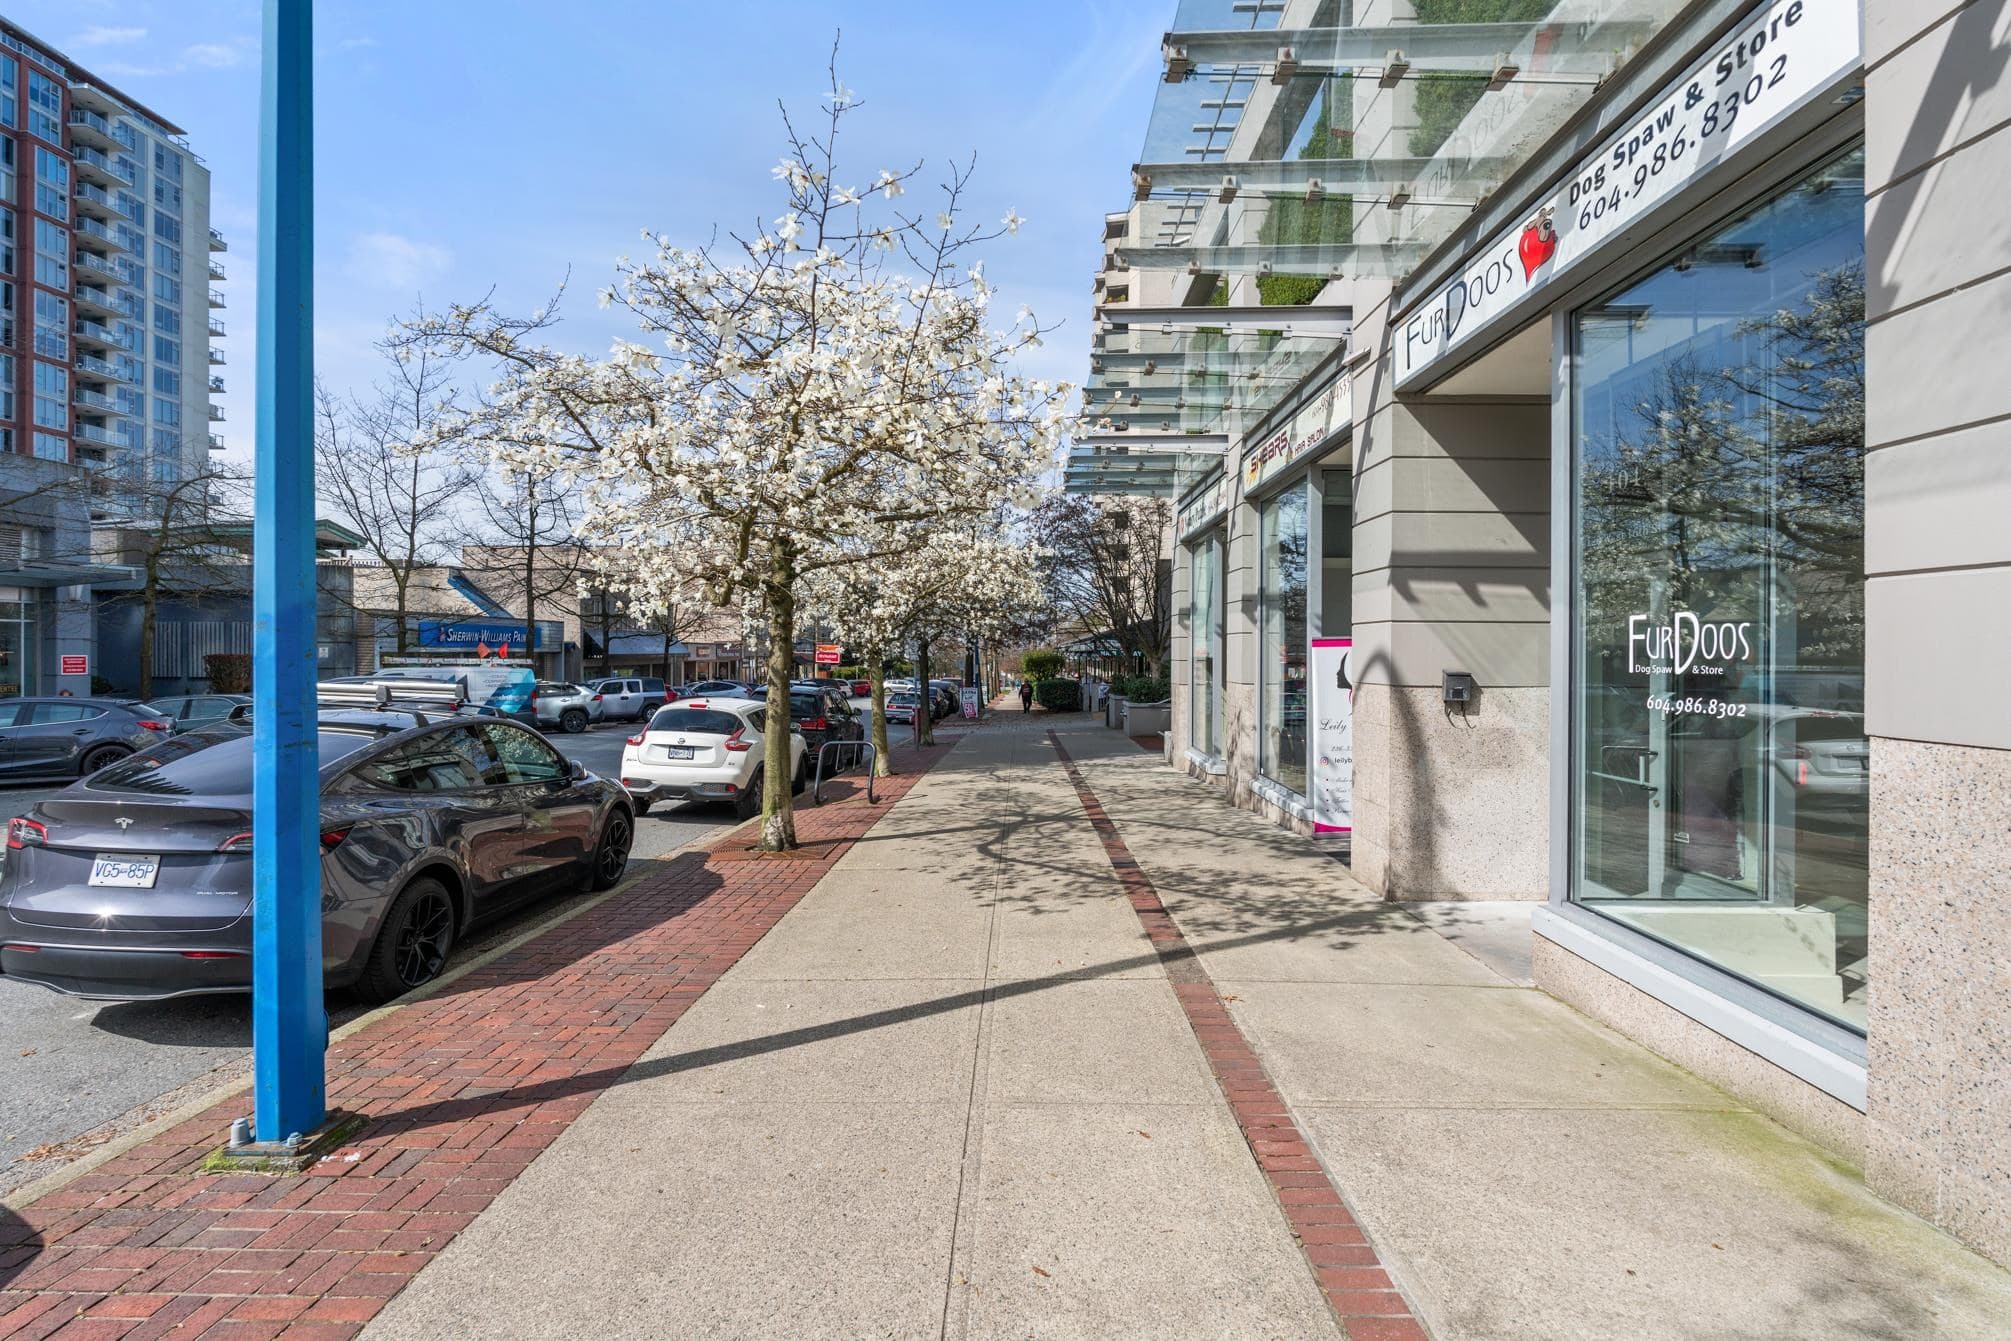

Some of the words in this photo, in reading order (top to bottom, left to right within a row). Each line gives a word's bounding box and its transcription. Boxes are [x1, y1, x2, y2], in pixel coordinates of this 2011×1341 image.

[1569, 163, 1606, 207] Dog
[1612, 103, 1676, 172] Spaw
[1684, 81, 1705, 111] &
[1715, 0, 1804, 87] Store
[1579, 53, 1788, 231] 604.986.8302
[1635, 664, 1651, 675] Dog
[1651, 664, 1673, 675] Spaw
[1692, 665, 1700, 675] &
[1701, 664, 1724, 675] Store
[1646, 694, 1747, 719] 604.986.8302
[1320, 719, 1348, 735] Leily
